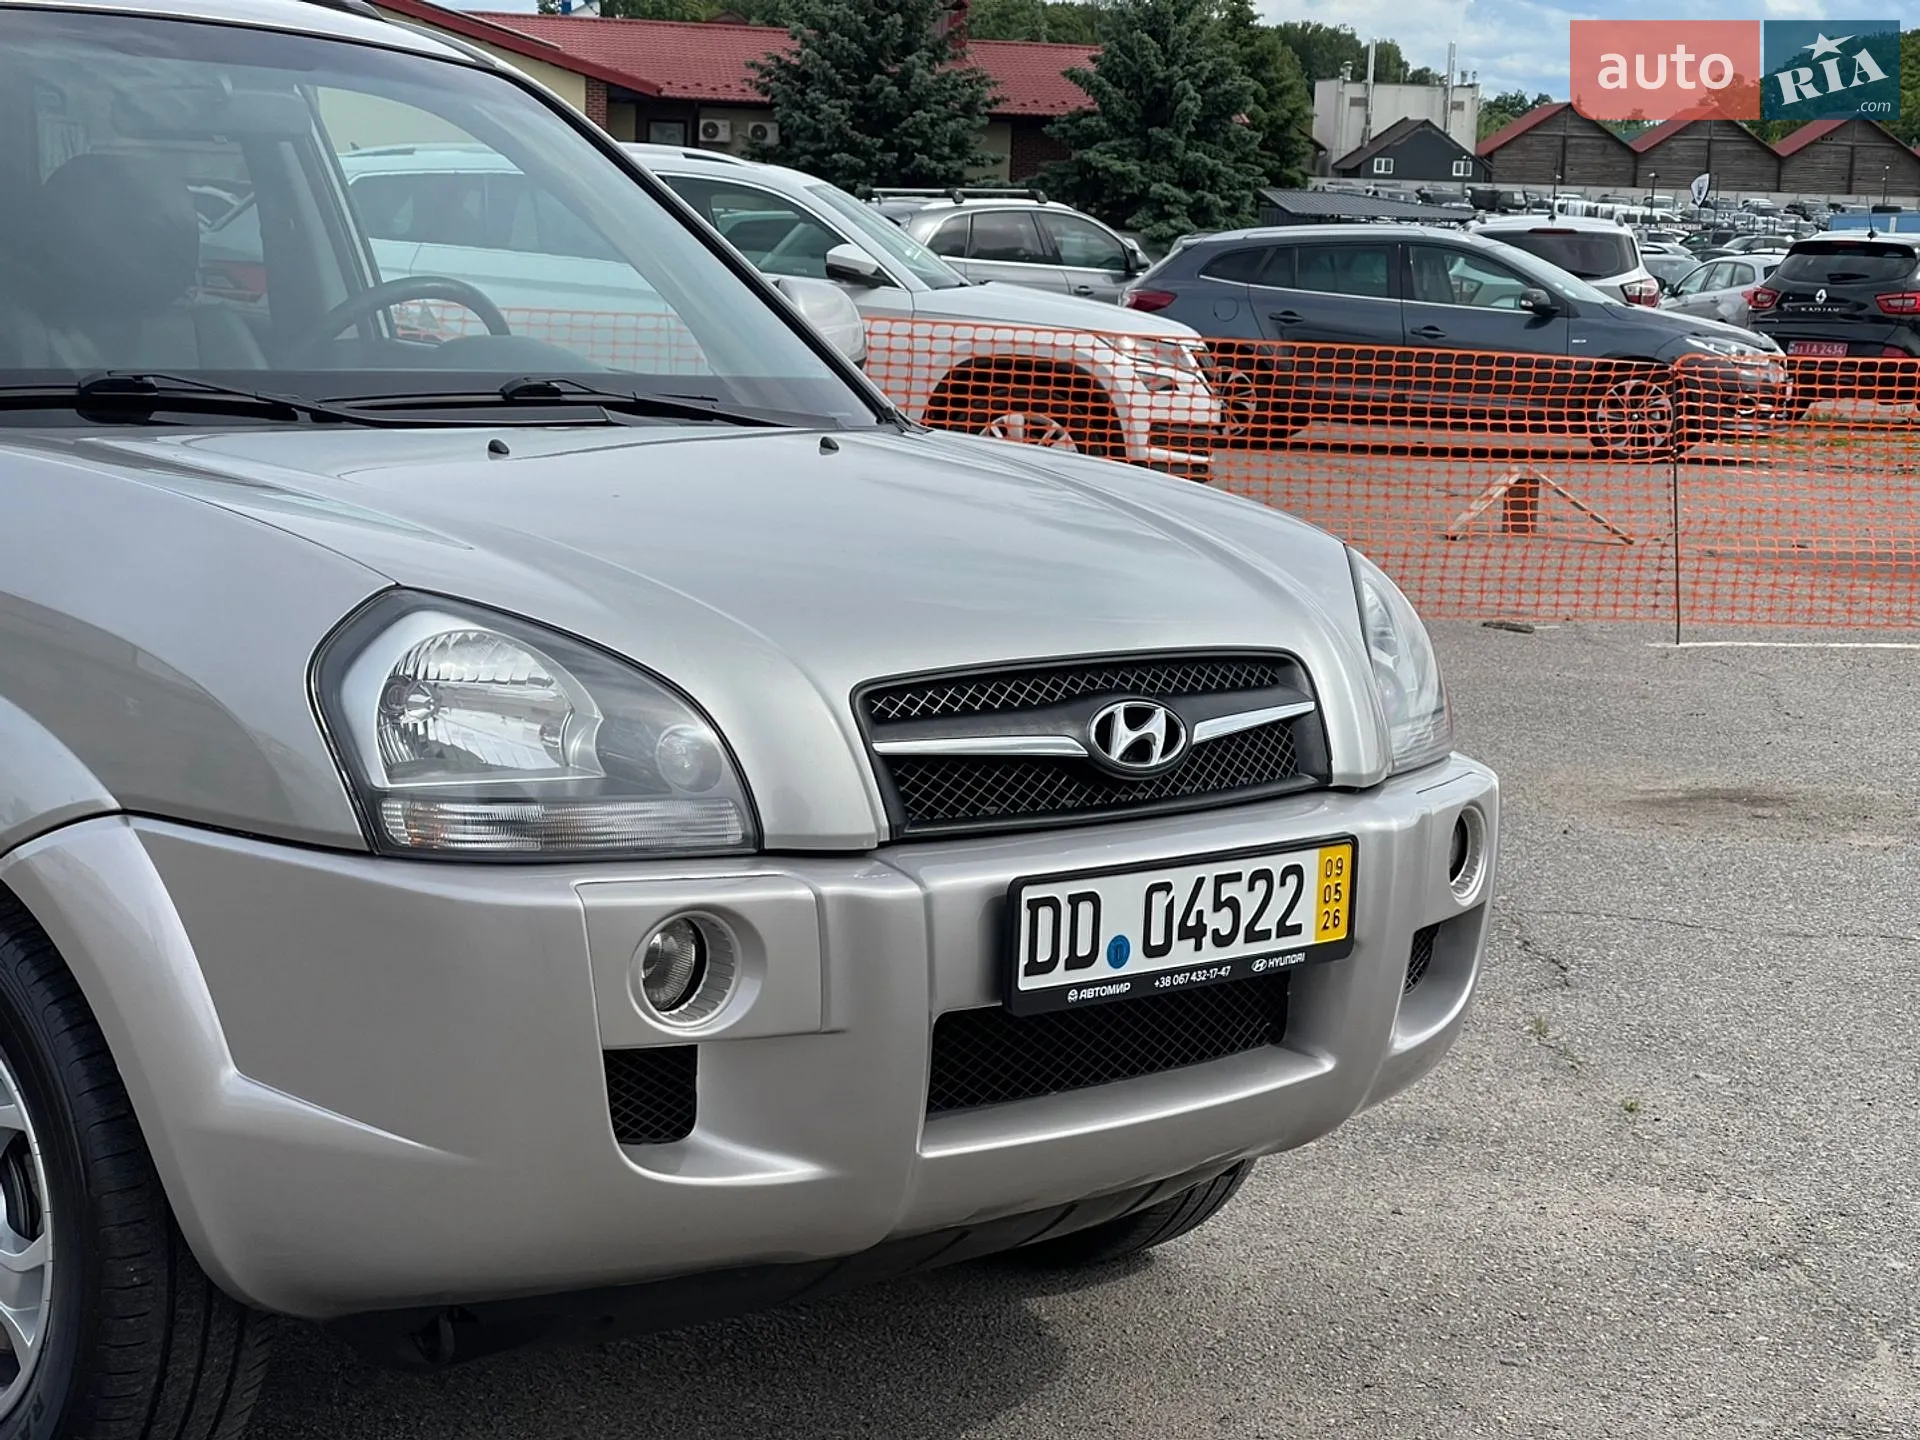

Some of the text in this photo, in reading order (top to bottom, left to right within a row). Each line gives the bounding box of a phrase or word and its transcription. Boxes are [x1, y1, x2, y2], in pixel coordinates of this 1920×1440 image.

[1325, 857, 1344, 878] 09
[1323, 883, 1342, 904] 05
[1024, 863, 1304, 977] DD 04522
[1322, 908, 1341, 930] 26
[1268, 952, 1306, 968] HYUNDAI
[1154, 965, 1232, 988] +38 067 432-17-47
[1079, 982, 1131, 999] АВТОМИР
